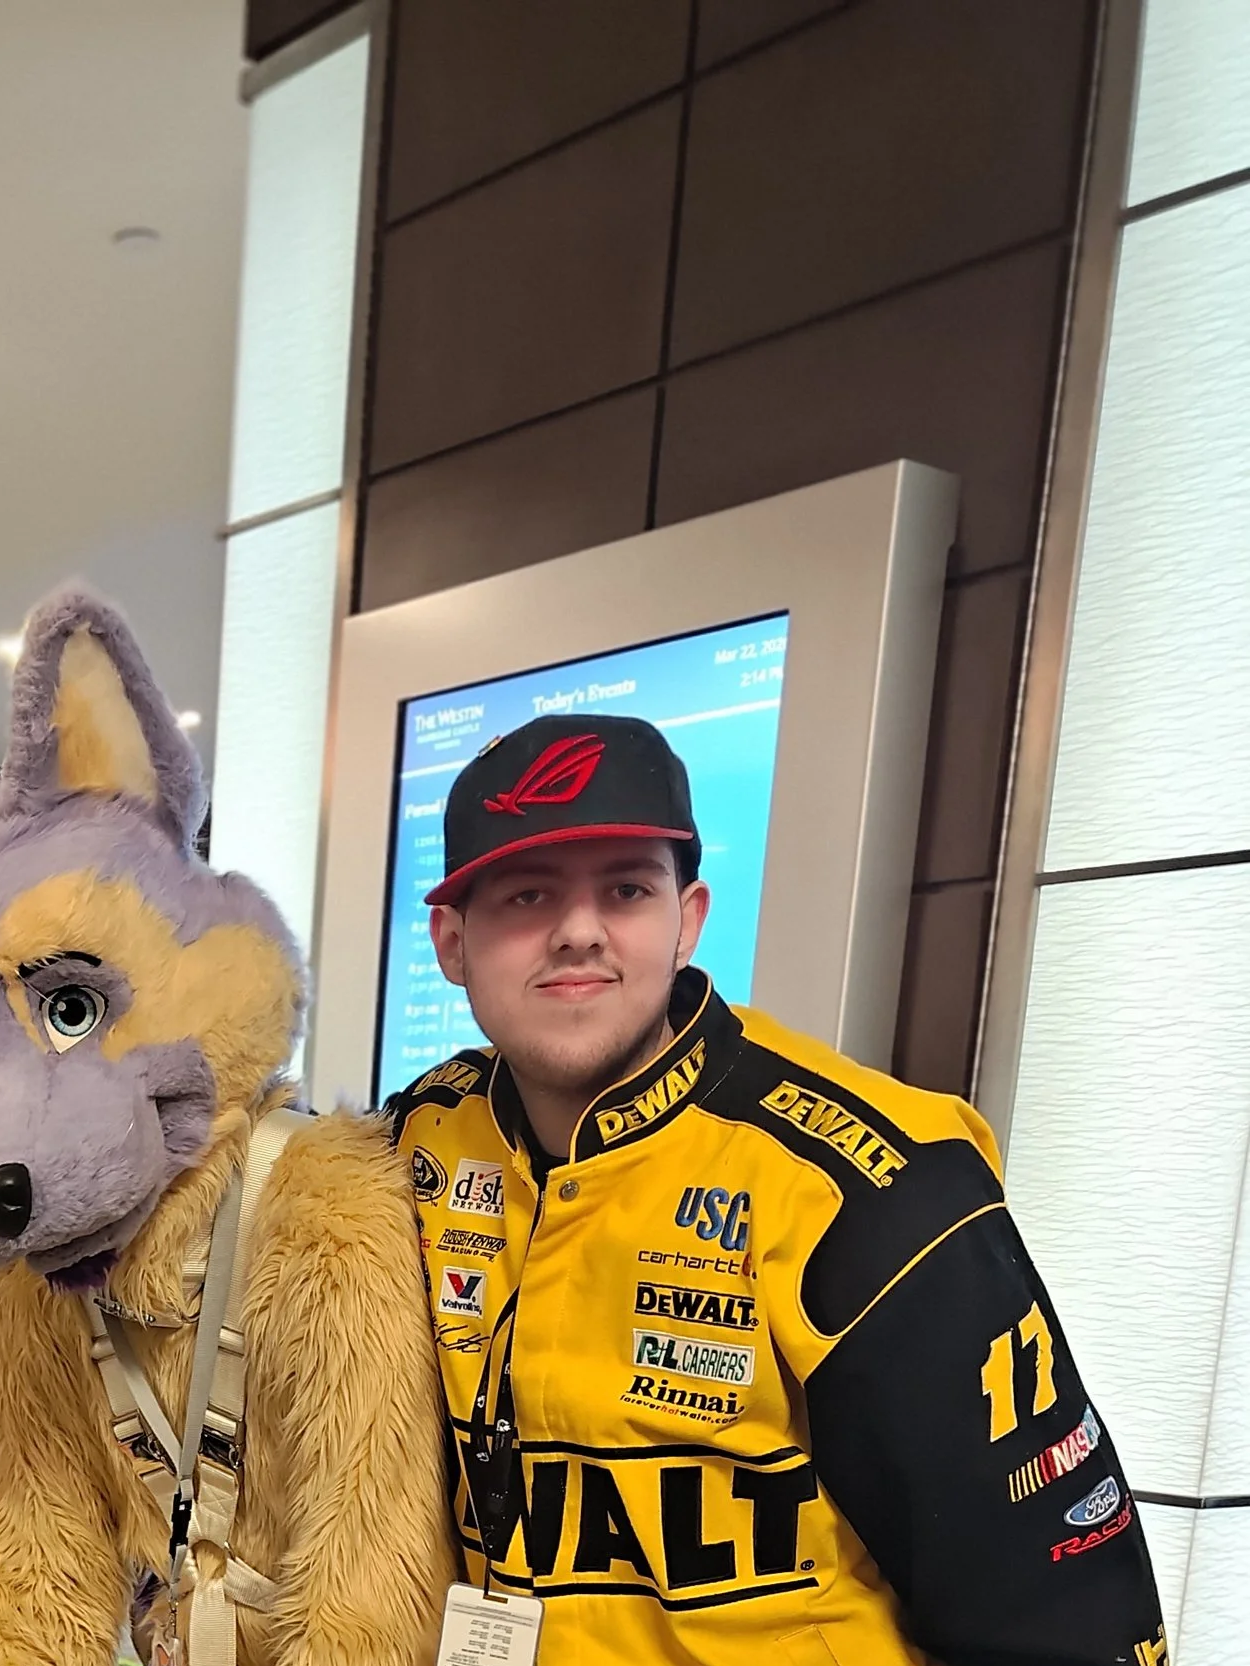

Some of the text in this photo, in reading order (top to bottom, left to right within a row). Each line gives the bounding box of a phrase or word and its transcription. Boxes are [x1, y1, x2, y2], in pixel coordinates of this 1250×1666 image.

[714, 648, 738, 666] Mar
[532, 679, 637, 714] Today's Events
[740, 670, 767, 688] 2:14
[675, 1187, 750, 1251] USG
[638, 1250, 740, 1275] carhartt
[636, 1285, 755, 1327] DEWALT
[682, 1344, 748, 1382] CARRIERS
[980, 1299, 1058, 1443] 17
[619, 1394, 739, 1425] foreverhotwater.com
[626, 1374, 745, 1415] Rinnai
